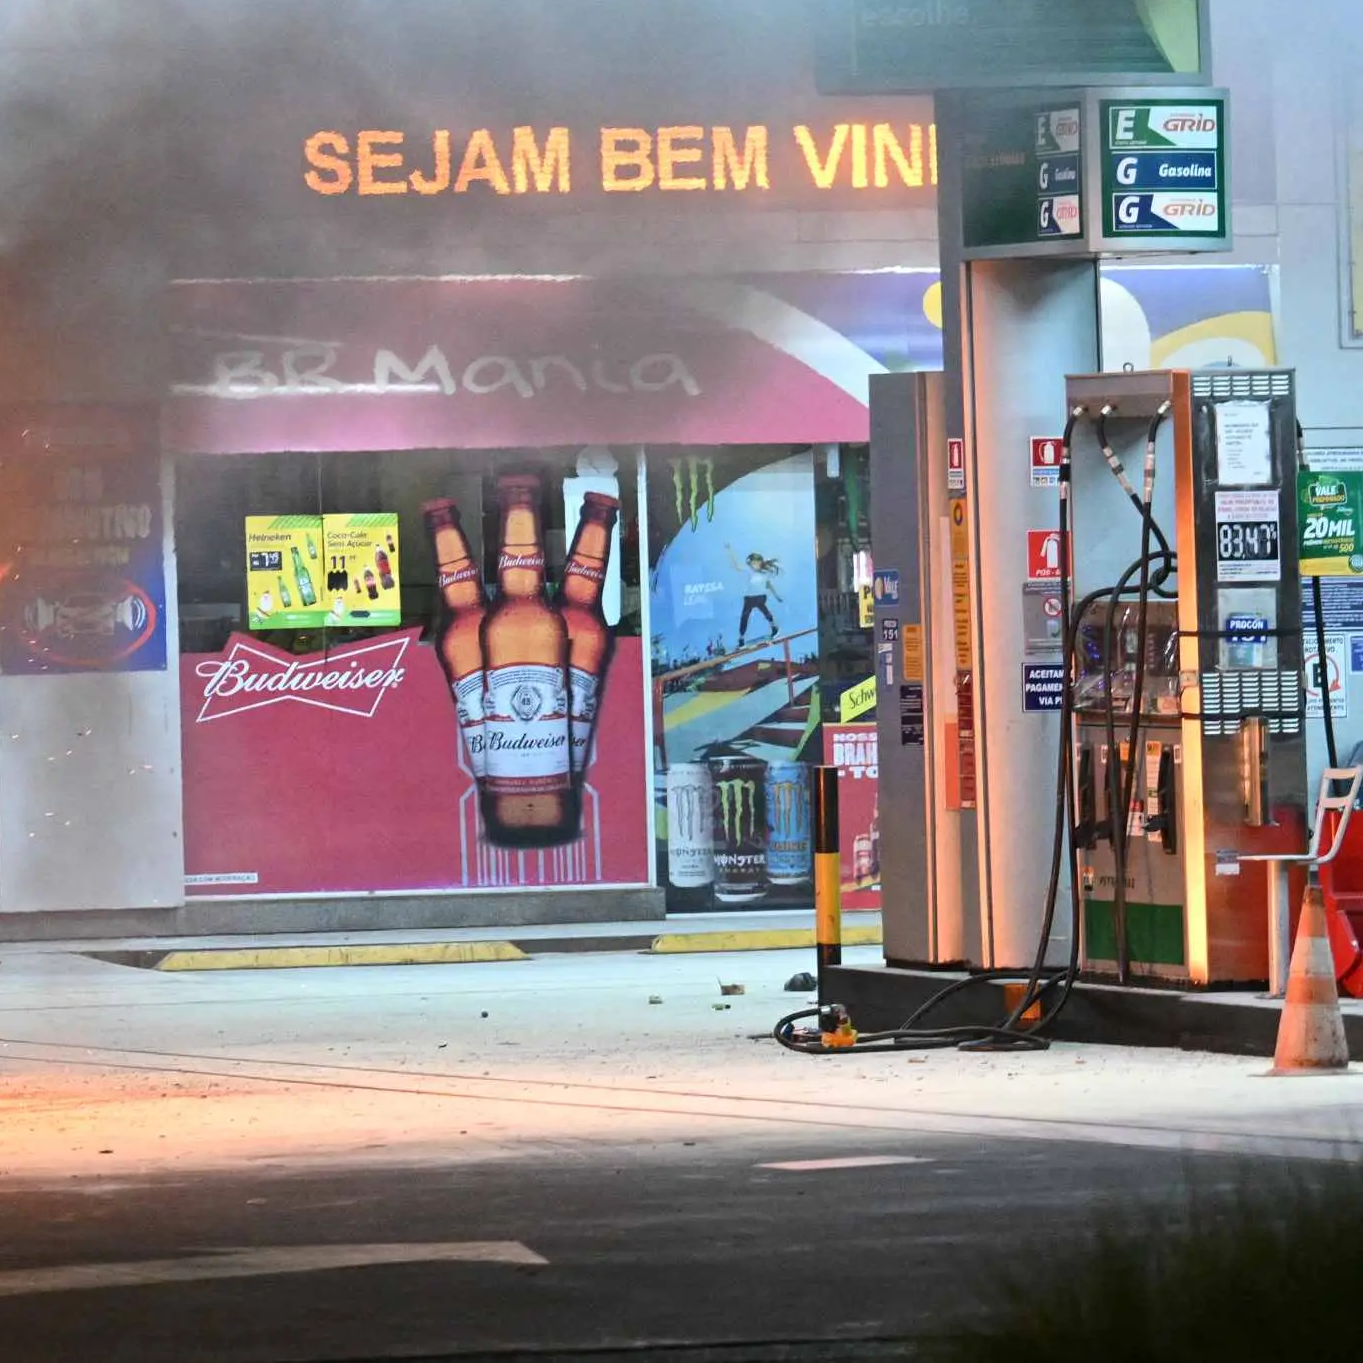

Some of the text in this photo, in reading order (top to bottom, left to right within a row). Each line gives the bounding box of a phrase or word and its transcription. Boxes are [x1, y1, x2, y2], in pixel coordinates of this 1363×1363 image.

[1116, 110, 1136, 140] E
[303, 121, 938, 196] SEJAM BEM VIN
[1116, 156, 1212, 186] G Gasolina
[1118, 195, 1140, 224] G
[214, 344, 703, 399] BR Mania
[248, 533, 292, 542] Heineken
[1328, 518, 1356, 538] MIL
[1230, 619, 1264, 630] PROCON
[196, 659, 405, 697] Budweiser
[1039, 696, 1053, 705] VIA
